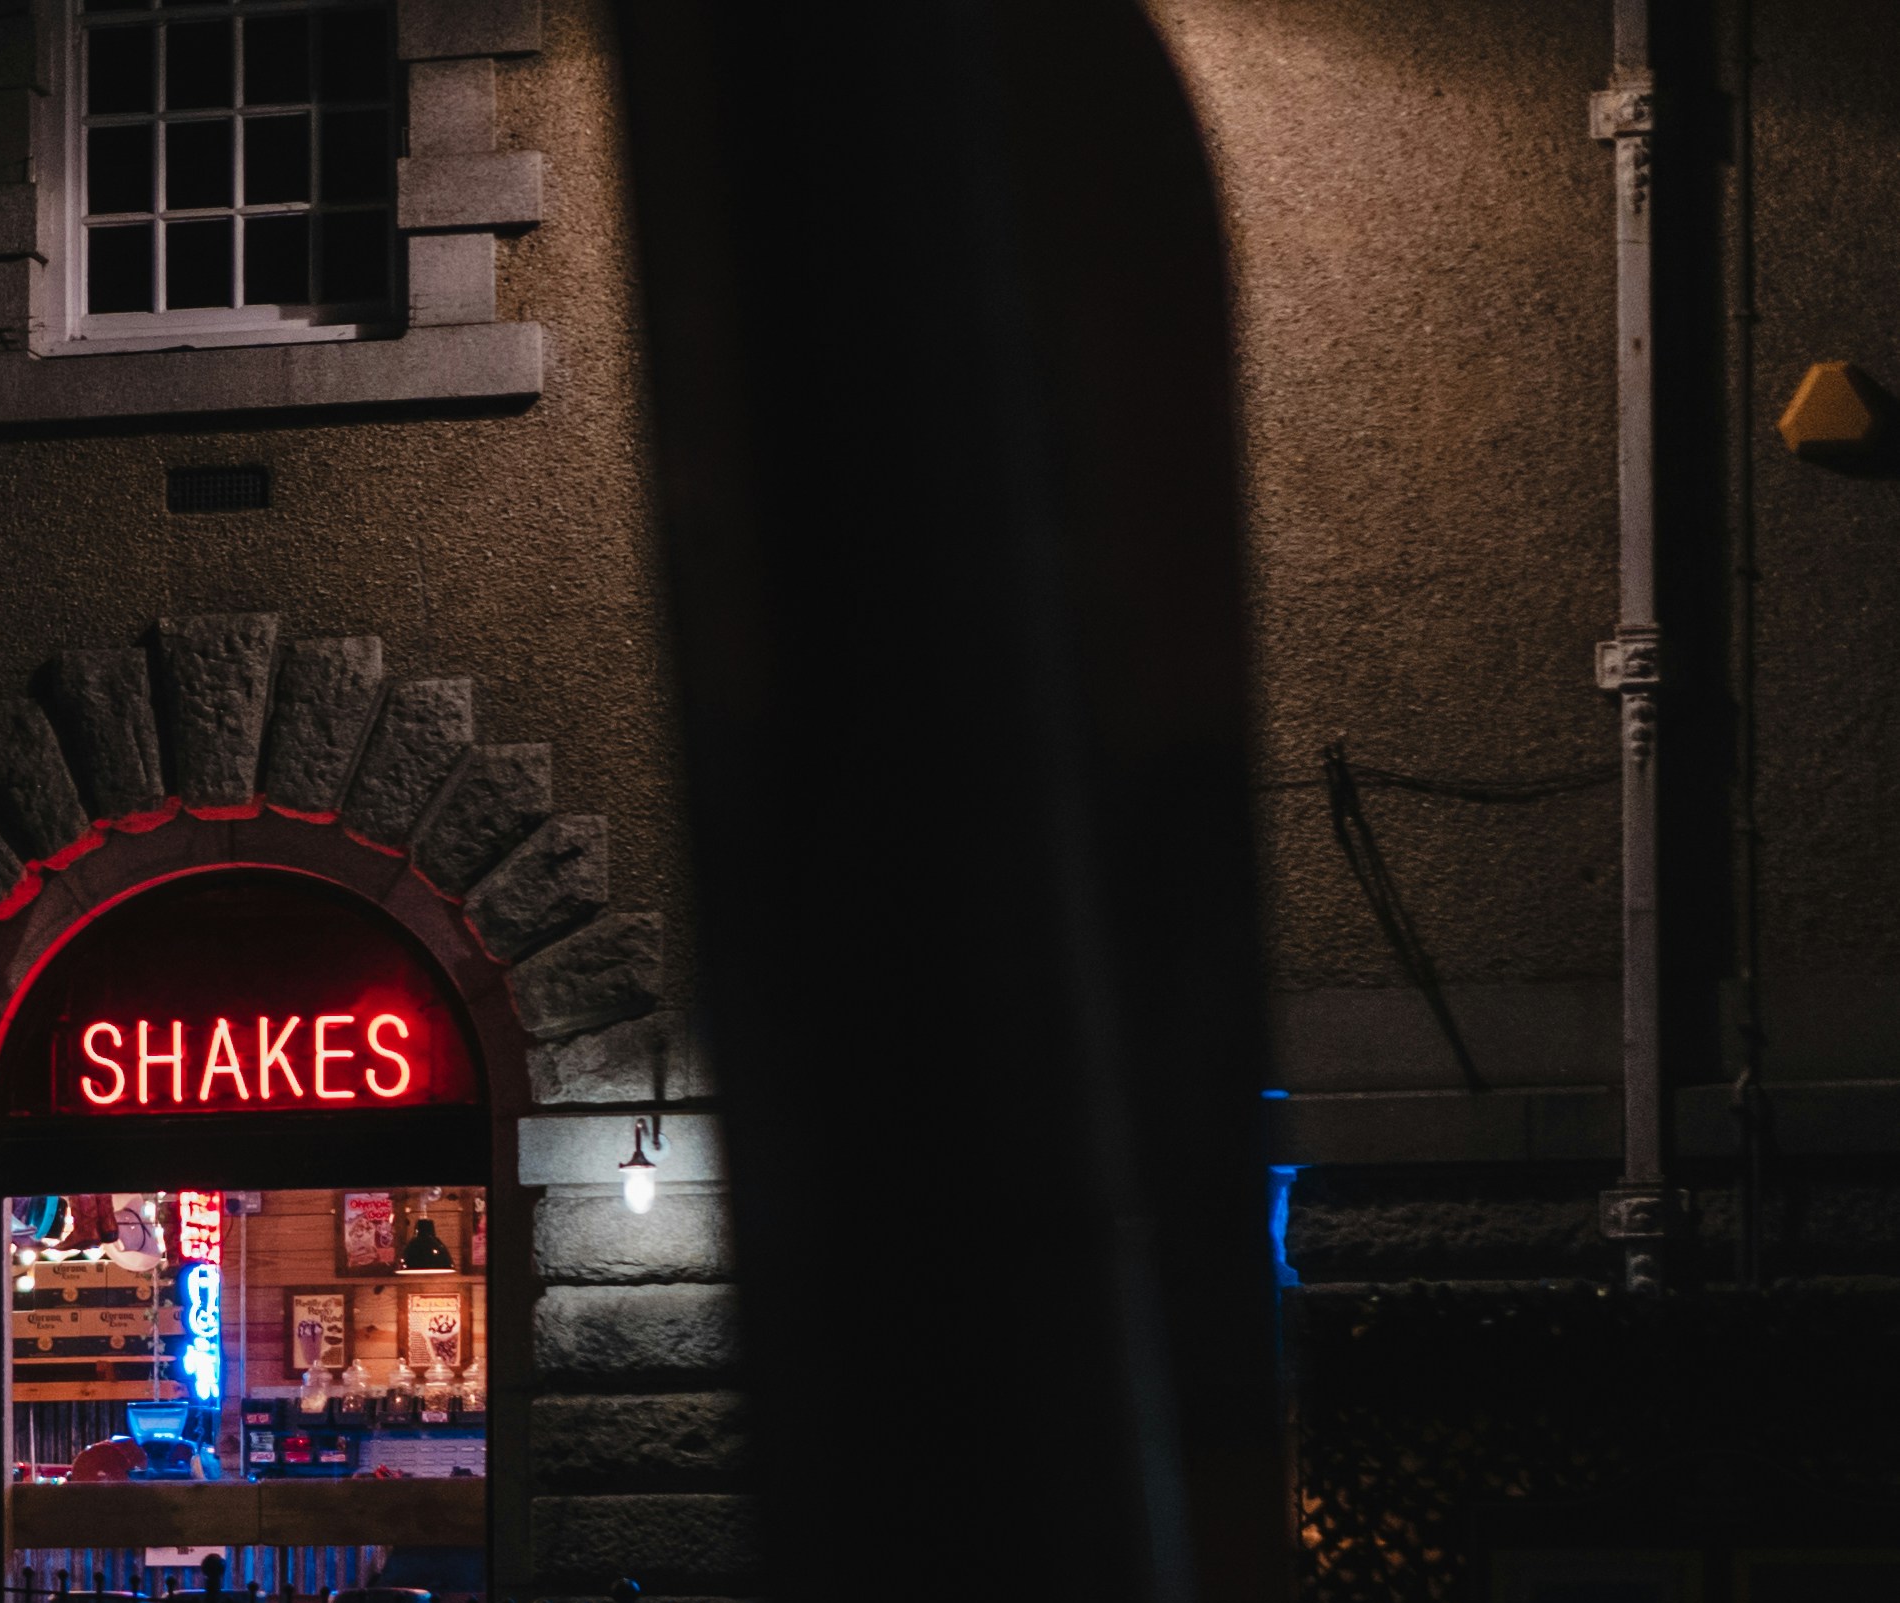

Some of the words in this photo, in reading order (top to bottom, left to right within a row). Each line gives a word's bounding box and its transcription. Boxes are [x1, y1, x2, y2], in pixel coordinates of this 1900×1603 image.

[81, 1014, 411, 1104] SHAKES
[53, 1264, 88, 1274] Corona
[27, 1313, 62, 1324] Corona
[100, 1312, 135, 1322] Corona
